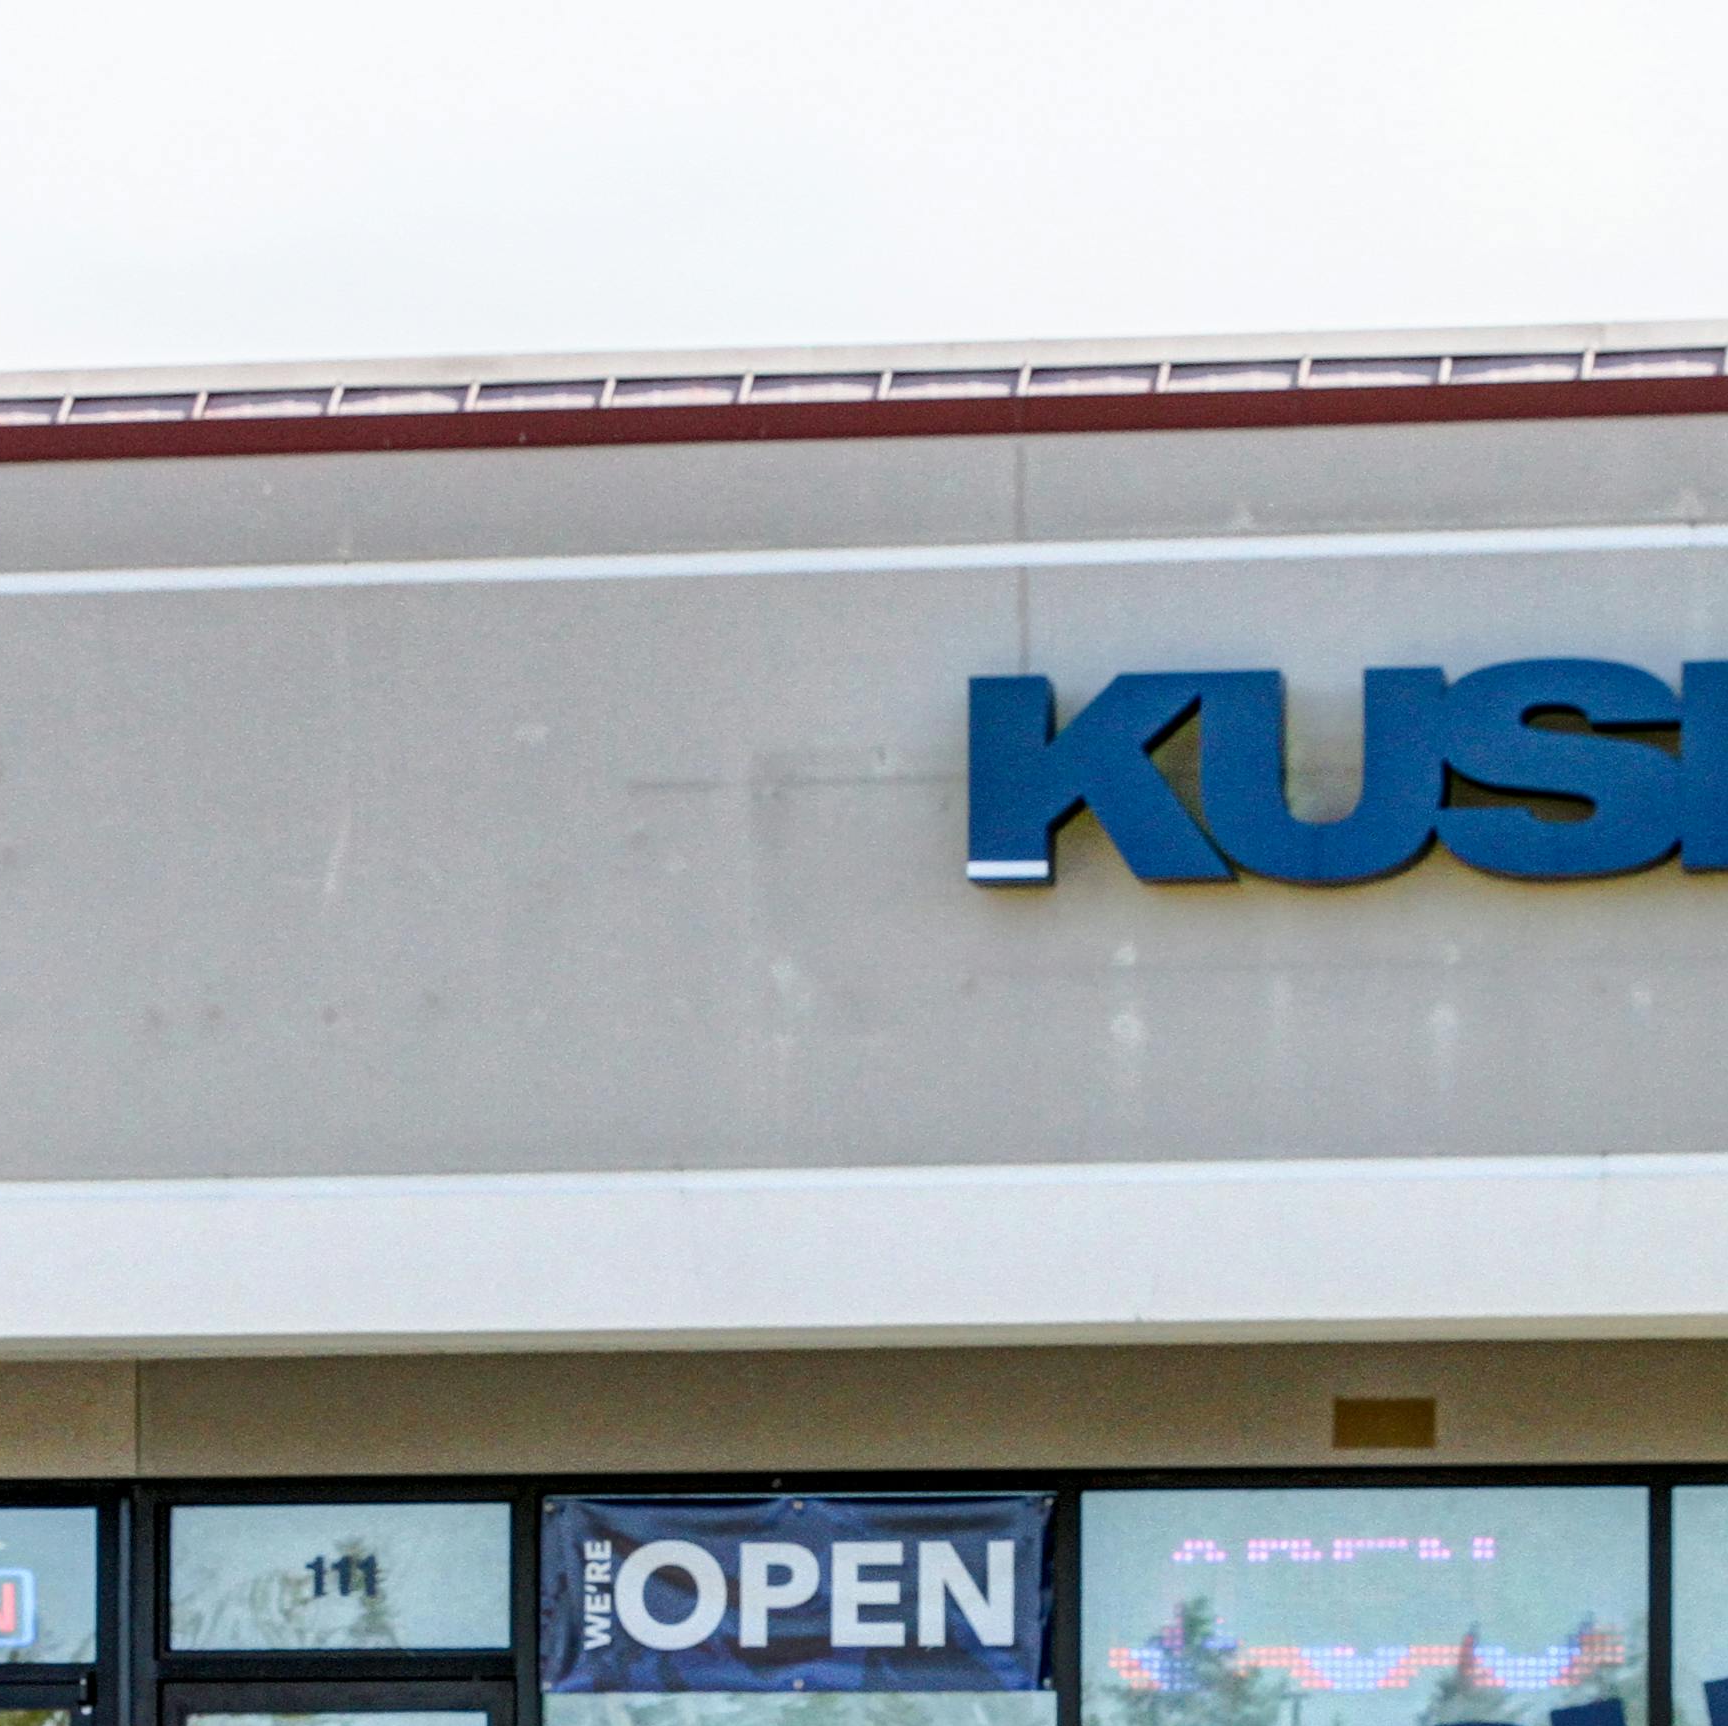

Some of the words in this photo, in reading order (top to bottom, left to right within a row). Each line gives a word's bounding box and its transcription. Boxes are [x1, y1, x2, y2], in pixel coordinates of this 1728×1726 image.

[306, 1555, 380, 1598] 111
[584, 1539, 612, 1650] WE'RE
[615, 1539, 1015, 1651] OPEN
